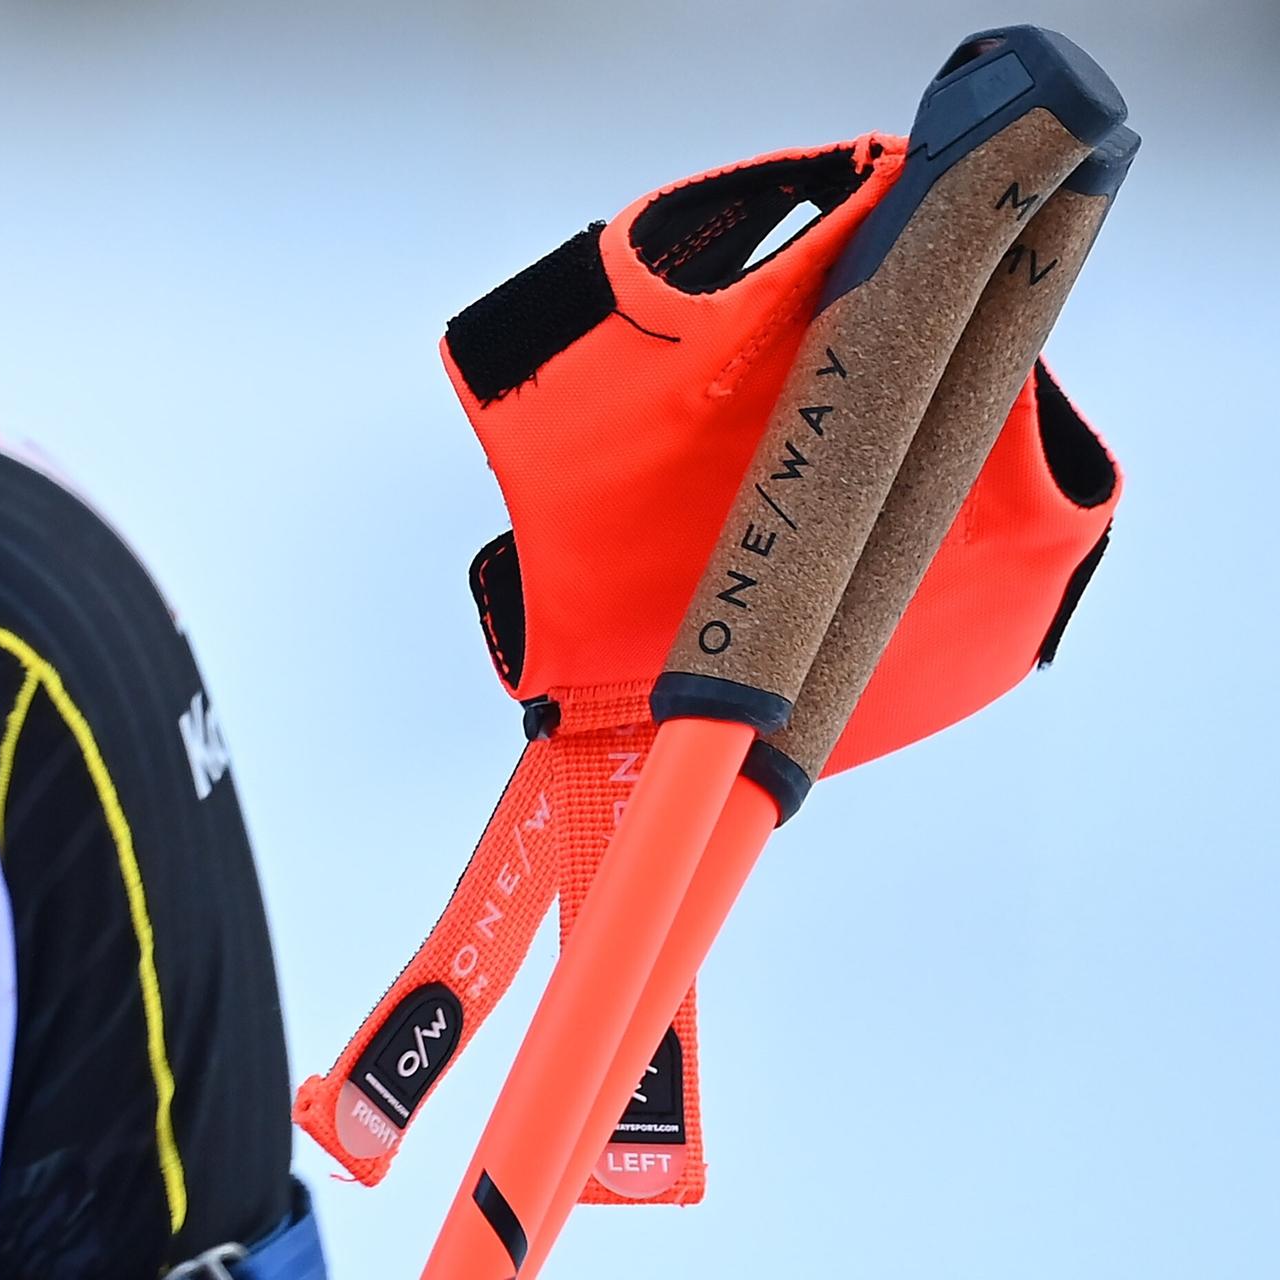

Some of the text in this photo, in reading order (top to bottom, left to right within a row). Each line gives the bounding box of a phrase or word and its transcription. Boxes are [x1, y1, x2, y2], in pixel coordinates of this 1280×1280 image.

[699, 347, 846, 654] ONE/WAY
[397, 1007, 447, 1077] O/W
[352, 1100, 400, 1148] RIGHT
[607, 1152, 671, 1173] LEFT
